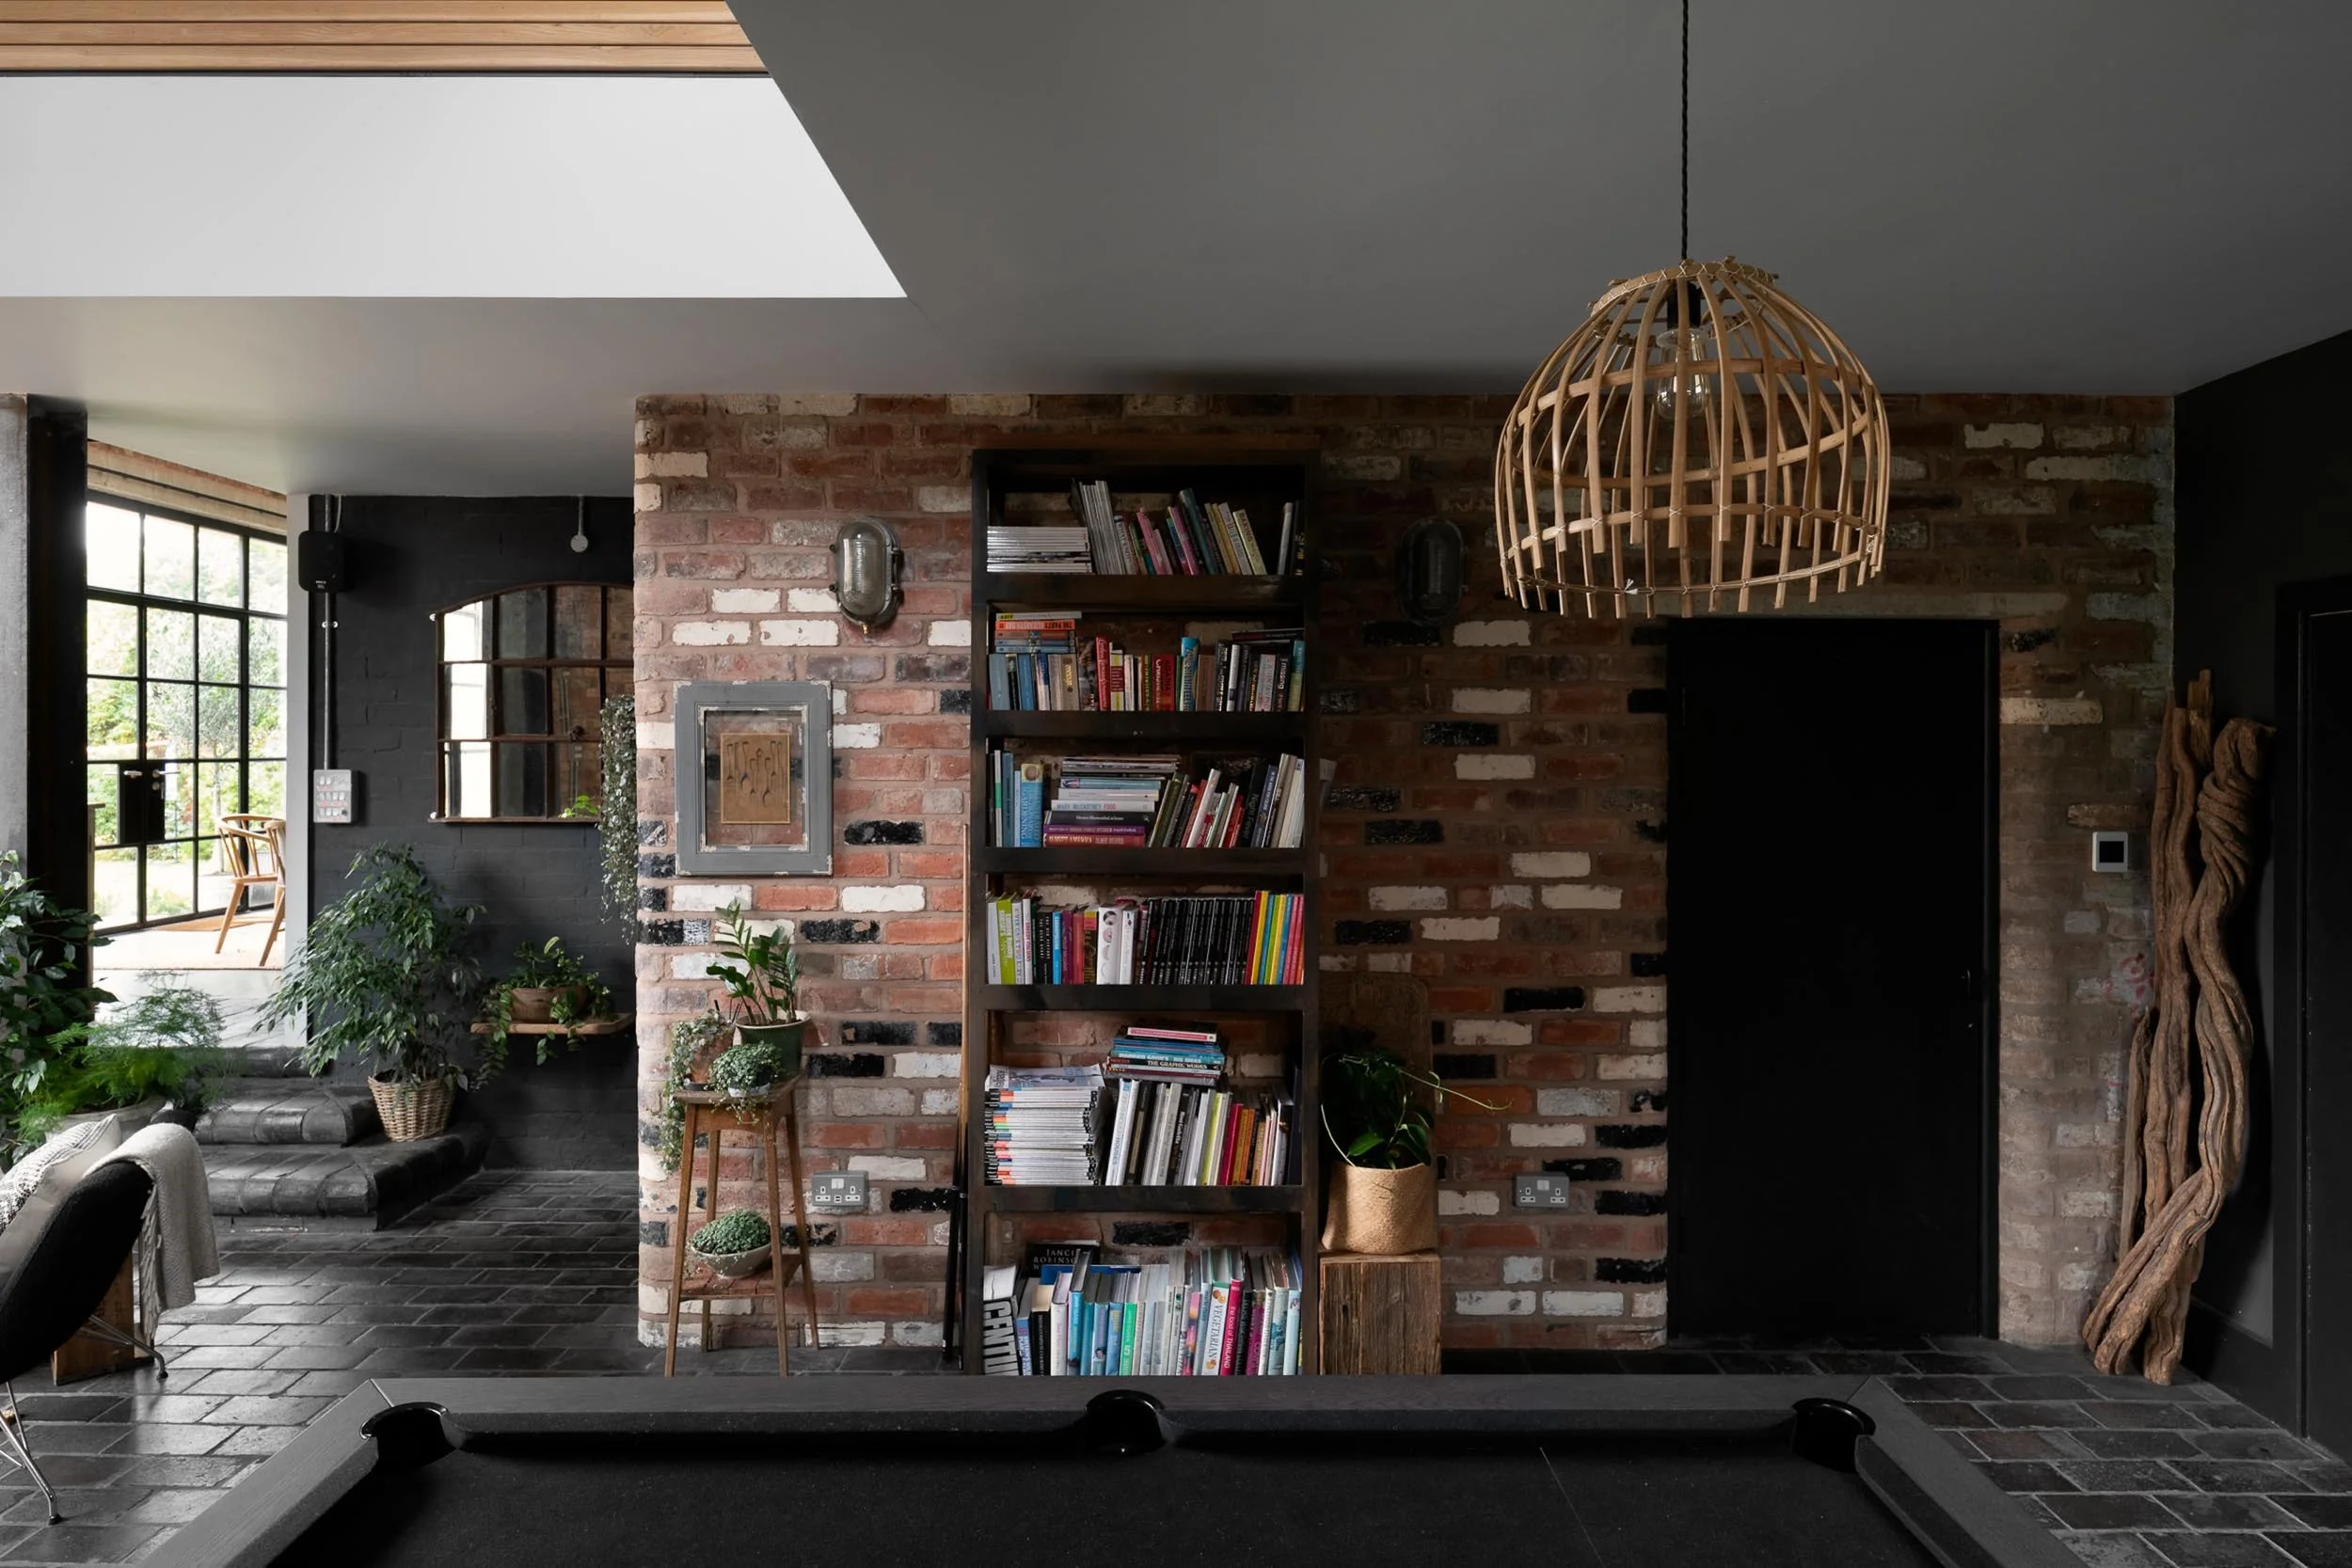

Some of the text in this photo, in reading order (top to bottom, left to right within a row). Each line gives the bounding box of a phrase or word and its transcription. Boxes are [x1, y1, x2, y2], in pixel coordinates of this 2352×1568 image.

[1248, 793, 1260, 816] Night
[983, 1301, 1020, 1376] CENTU
[1208, 1305, 1223, 1358] VEGETARIAN
[1224, 1338, 1233, 1369] THAILAND
